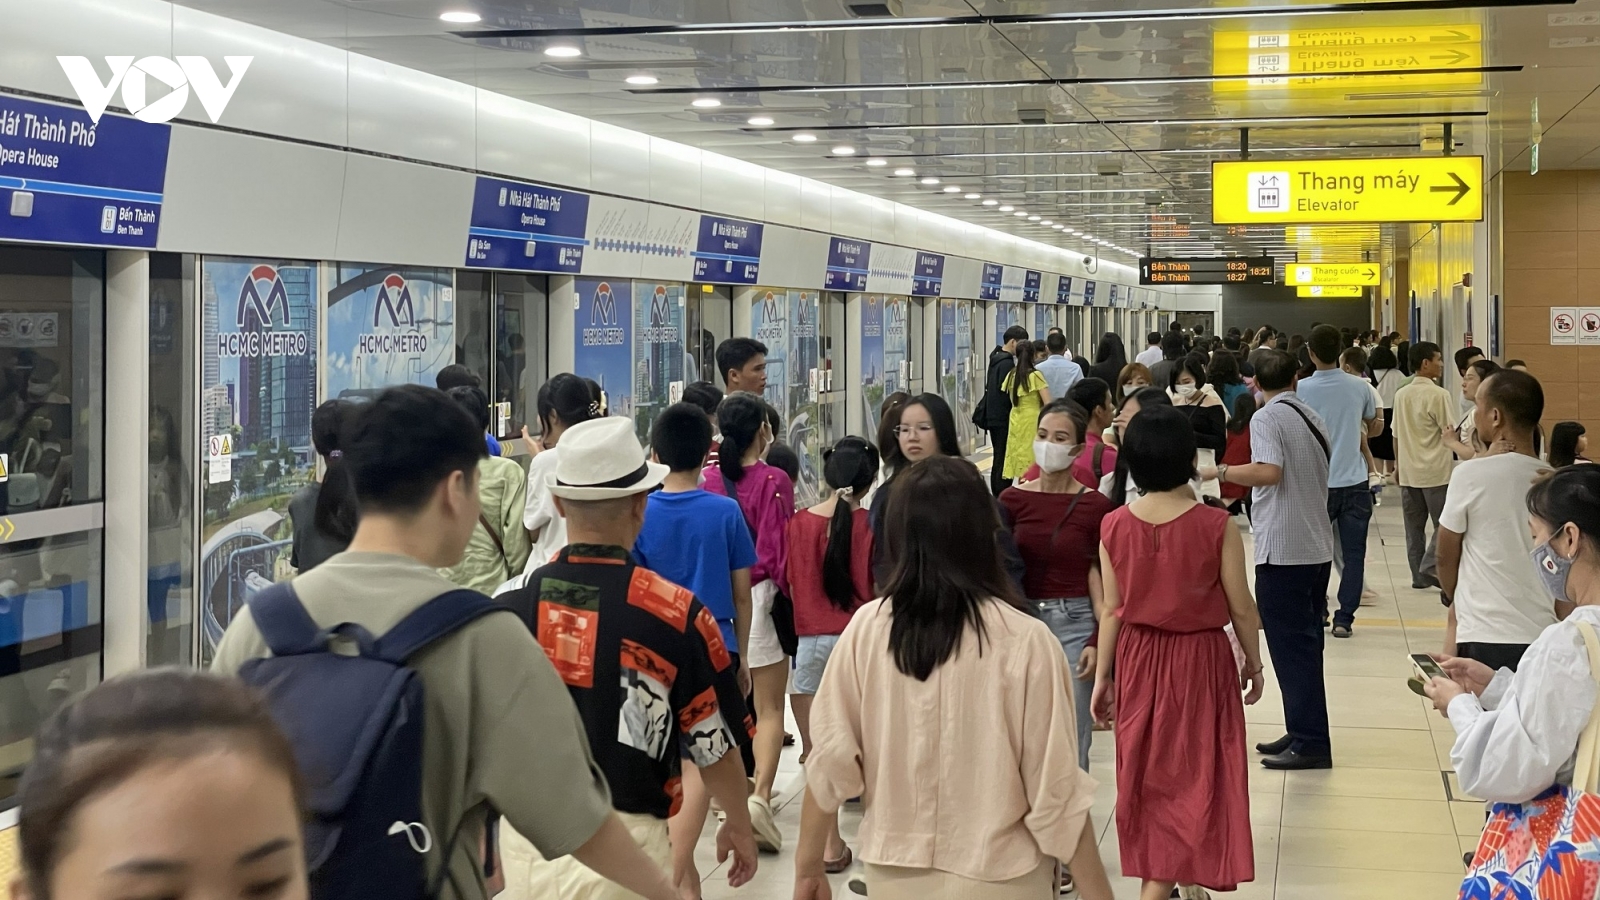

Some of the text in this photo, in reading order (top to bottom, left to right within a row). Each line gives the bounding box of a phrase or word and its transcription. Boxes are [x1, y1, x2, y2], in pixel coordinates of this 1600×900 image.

[24, 113, 66, 144] Thành
[70, 121, 98, 147] Phố
[27, 148, 59, 168] House
[1298, 169, 1420, 194] Thang máy
[1298, 198, 1359, 211] Elevator
[119, 206, 155, 223] Bến Thành
[117, 225, 143, 236] Ben Thanh
[1143, 265, 1148, 278] 1
[1226, 262, 1247, 270] 18:20
[1250, 268, 1270, 276] 18:21
[1315, 266, 1359, 276] Thang cuốn
[1226, 273, 1247, 281] 18:27
[218, 332, 307, 357] HCMC METRO
[359, 334, 427, 354] HCMC METRO
[583, 328, 624, 346] HCMC METRO
